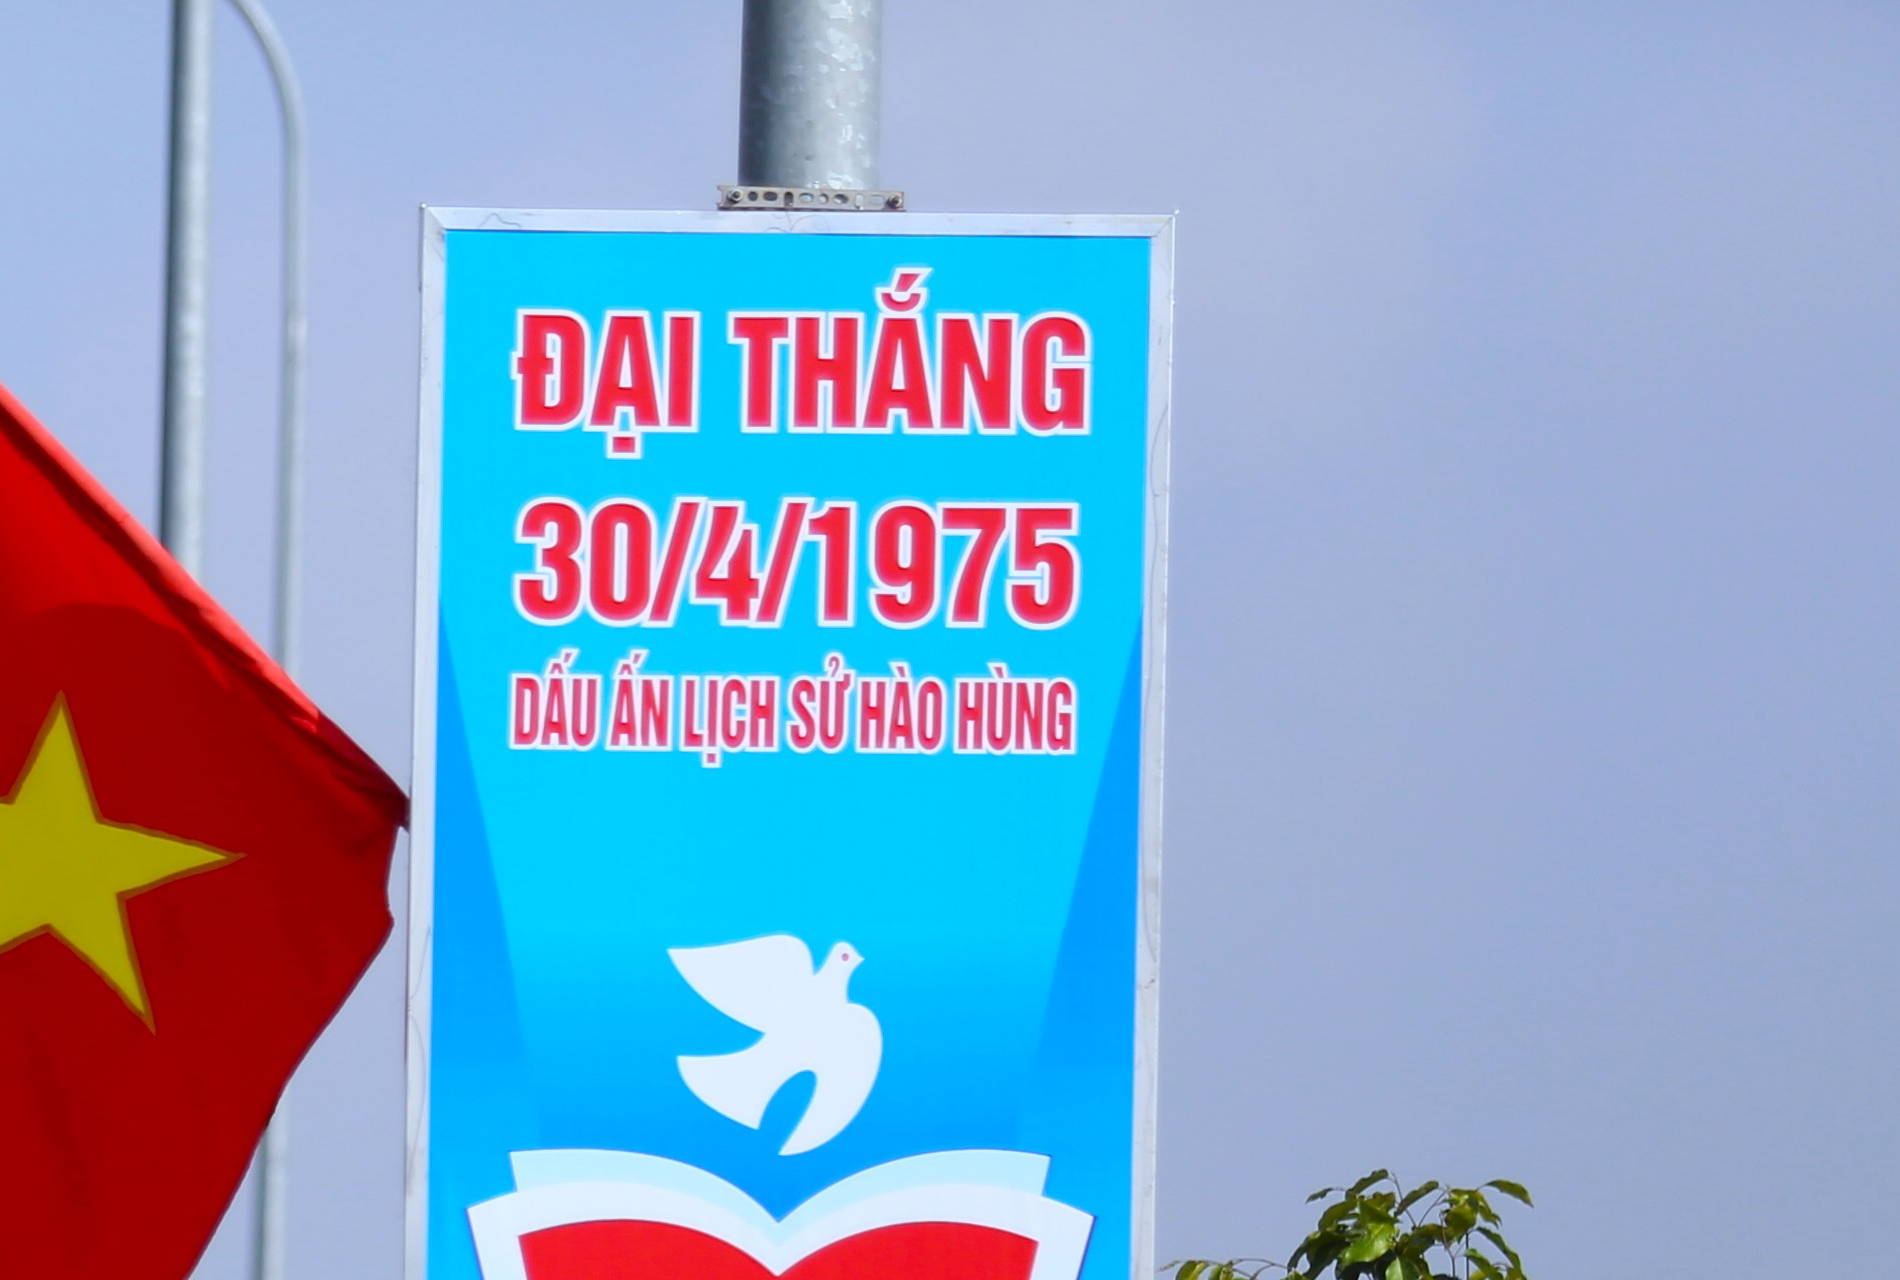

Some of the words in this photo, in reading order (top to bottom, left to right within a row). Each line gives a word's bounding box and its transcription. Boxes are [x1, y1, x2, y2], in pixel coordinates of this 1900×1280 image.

[515, 312, 696, 455] ĐẠI
[730, 270, 1088, 433] THẮNG
[517, 499, 1077, 626] 30/4/1975
[512, 650, 599, 748] DẤU
[610, 650, 671, 748] ẤN
[682, 676, 777, 765] LỊCH
[789, 655, 853, 751] SỬ
[858, 662, 945, 752] HÀO
[957, 662, 1074, 752] HÙNG
